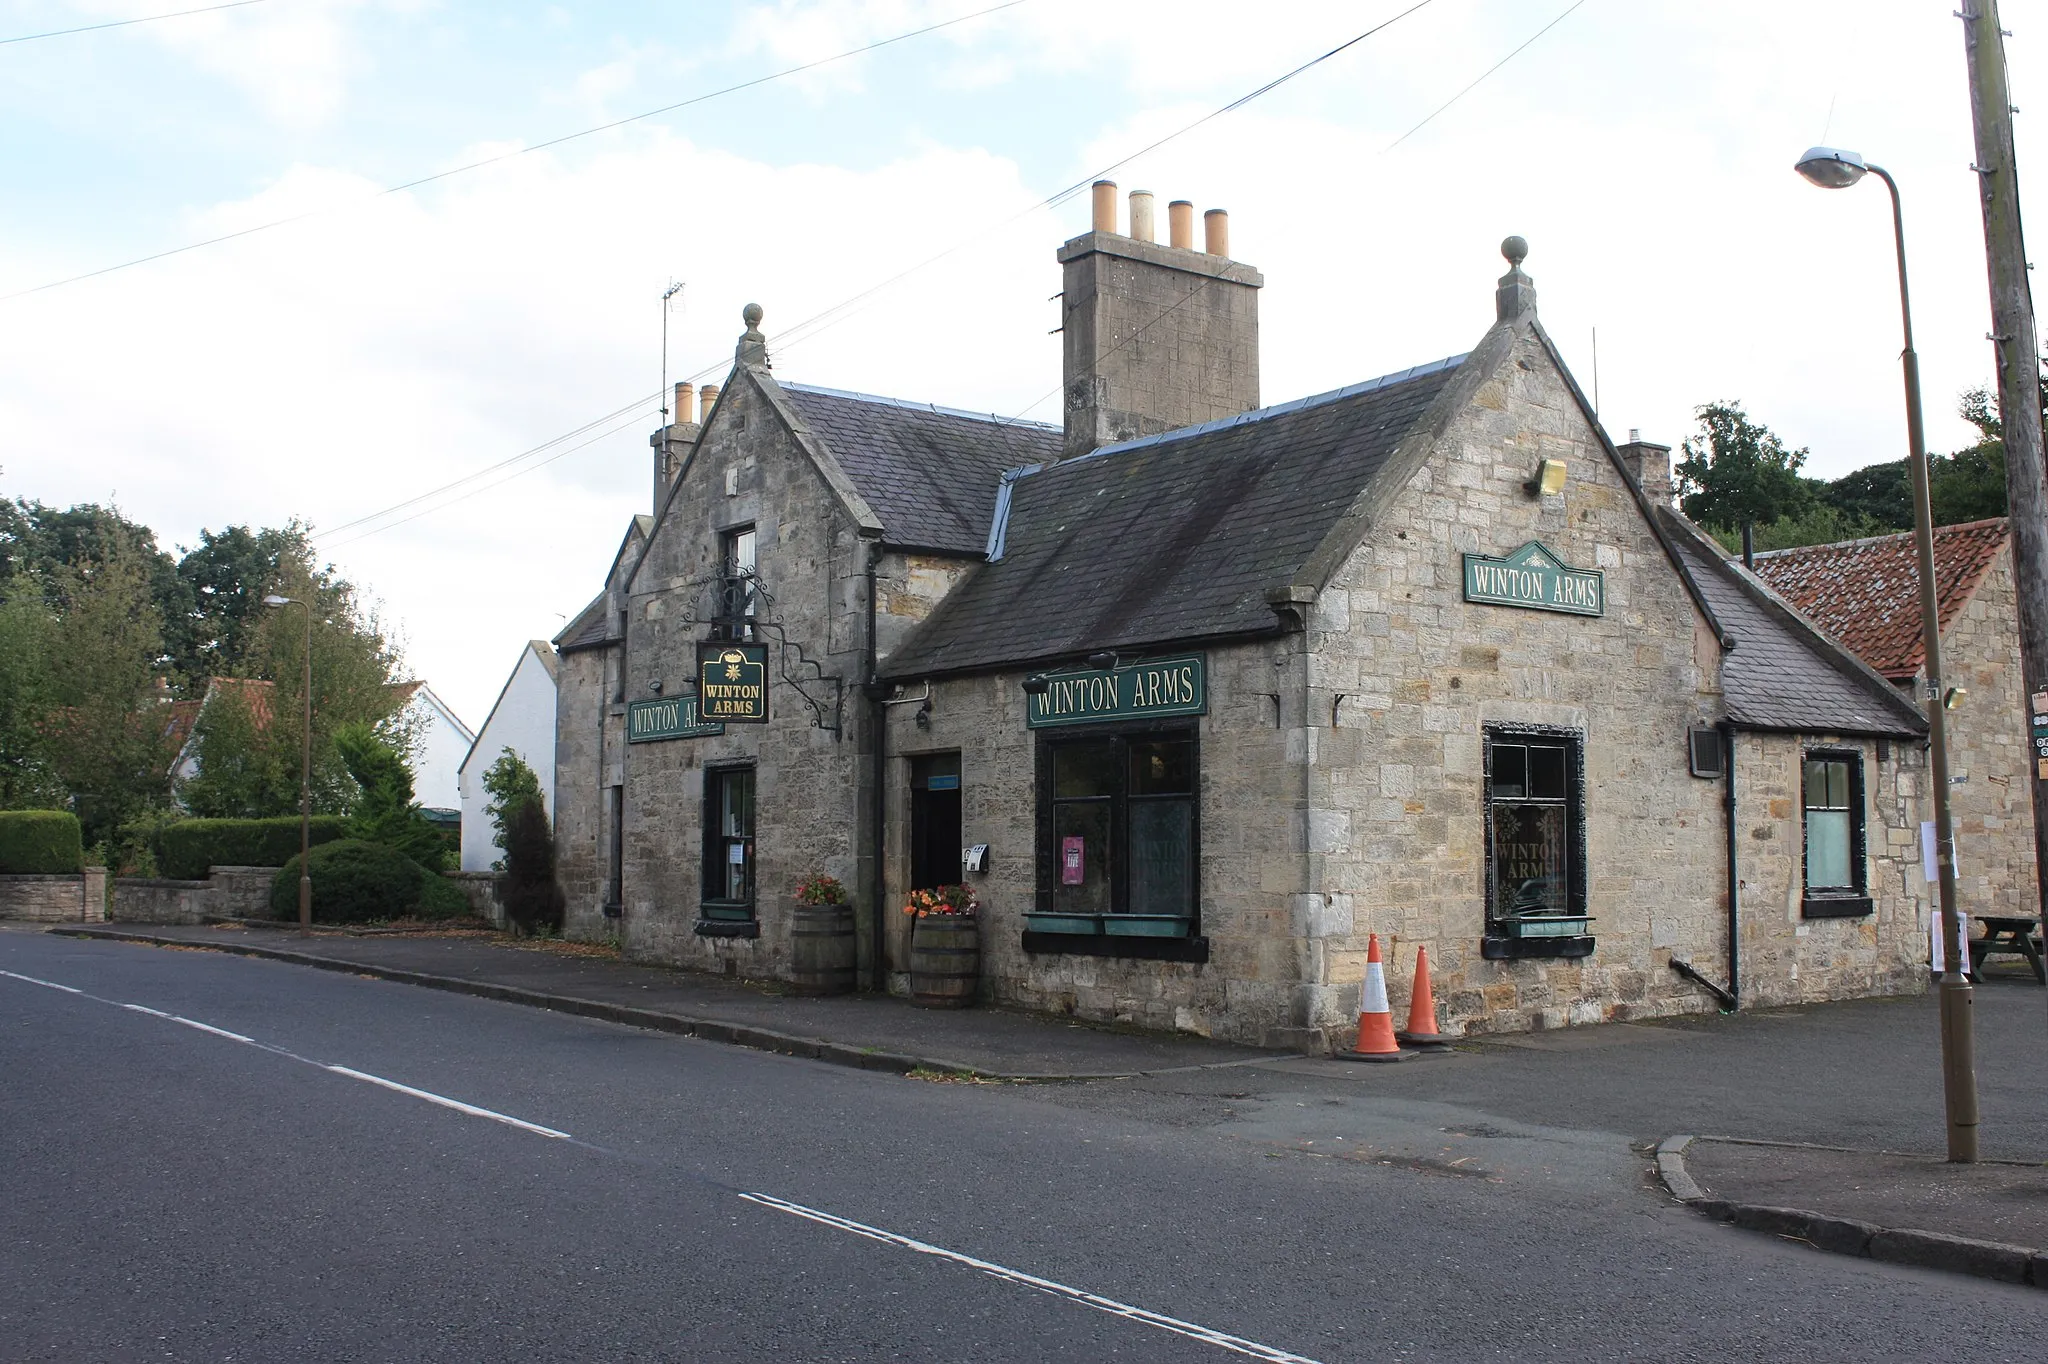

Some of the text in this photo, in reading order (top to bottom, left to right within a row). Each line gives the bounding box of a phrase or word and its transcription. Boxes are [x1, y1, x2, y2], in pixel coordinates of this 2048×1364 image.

[1474, 564, 1596, 607] WINTON ARMS
[706, 684, 760, 699] WINTON
[1038, 666, 1194, 716] WINTON ARMS
[713, 700, 754, 714] ARMS
[634, 703, 679, 733] WINTON
[1496, 843, 1560, 860] WINTON
[1507, 862, 1552, 879] ARMS
